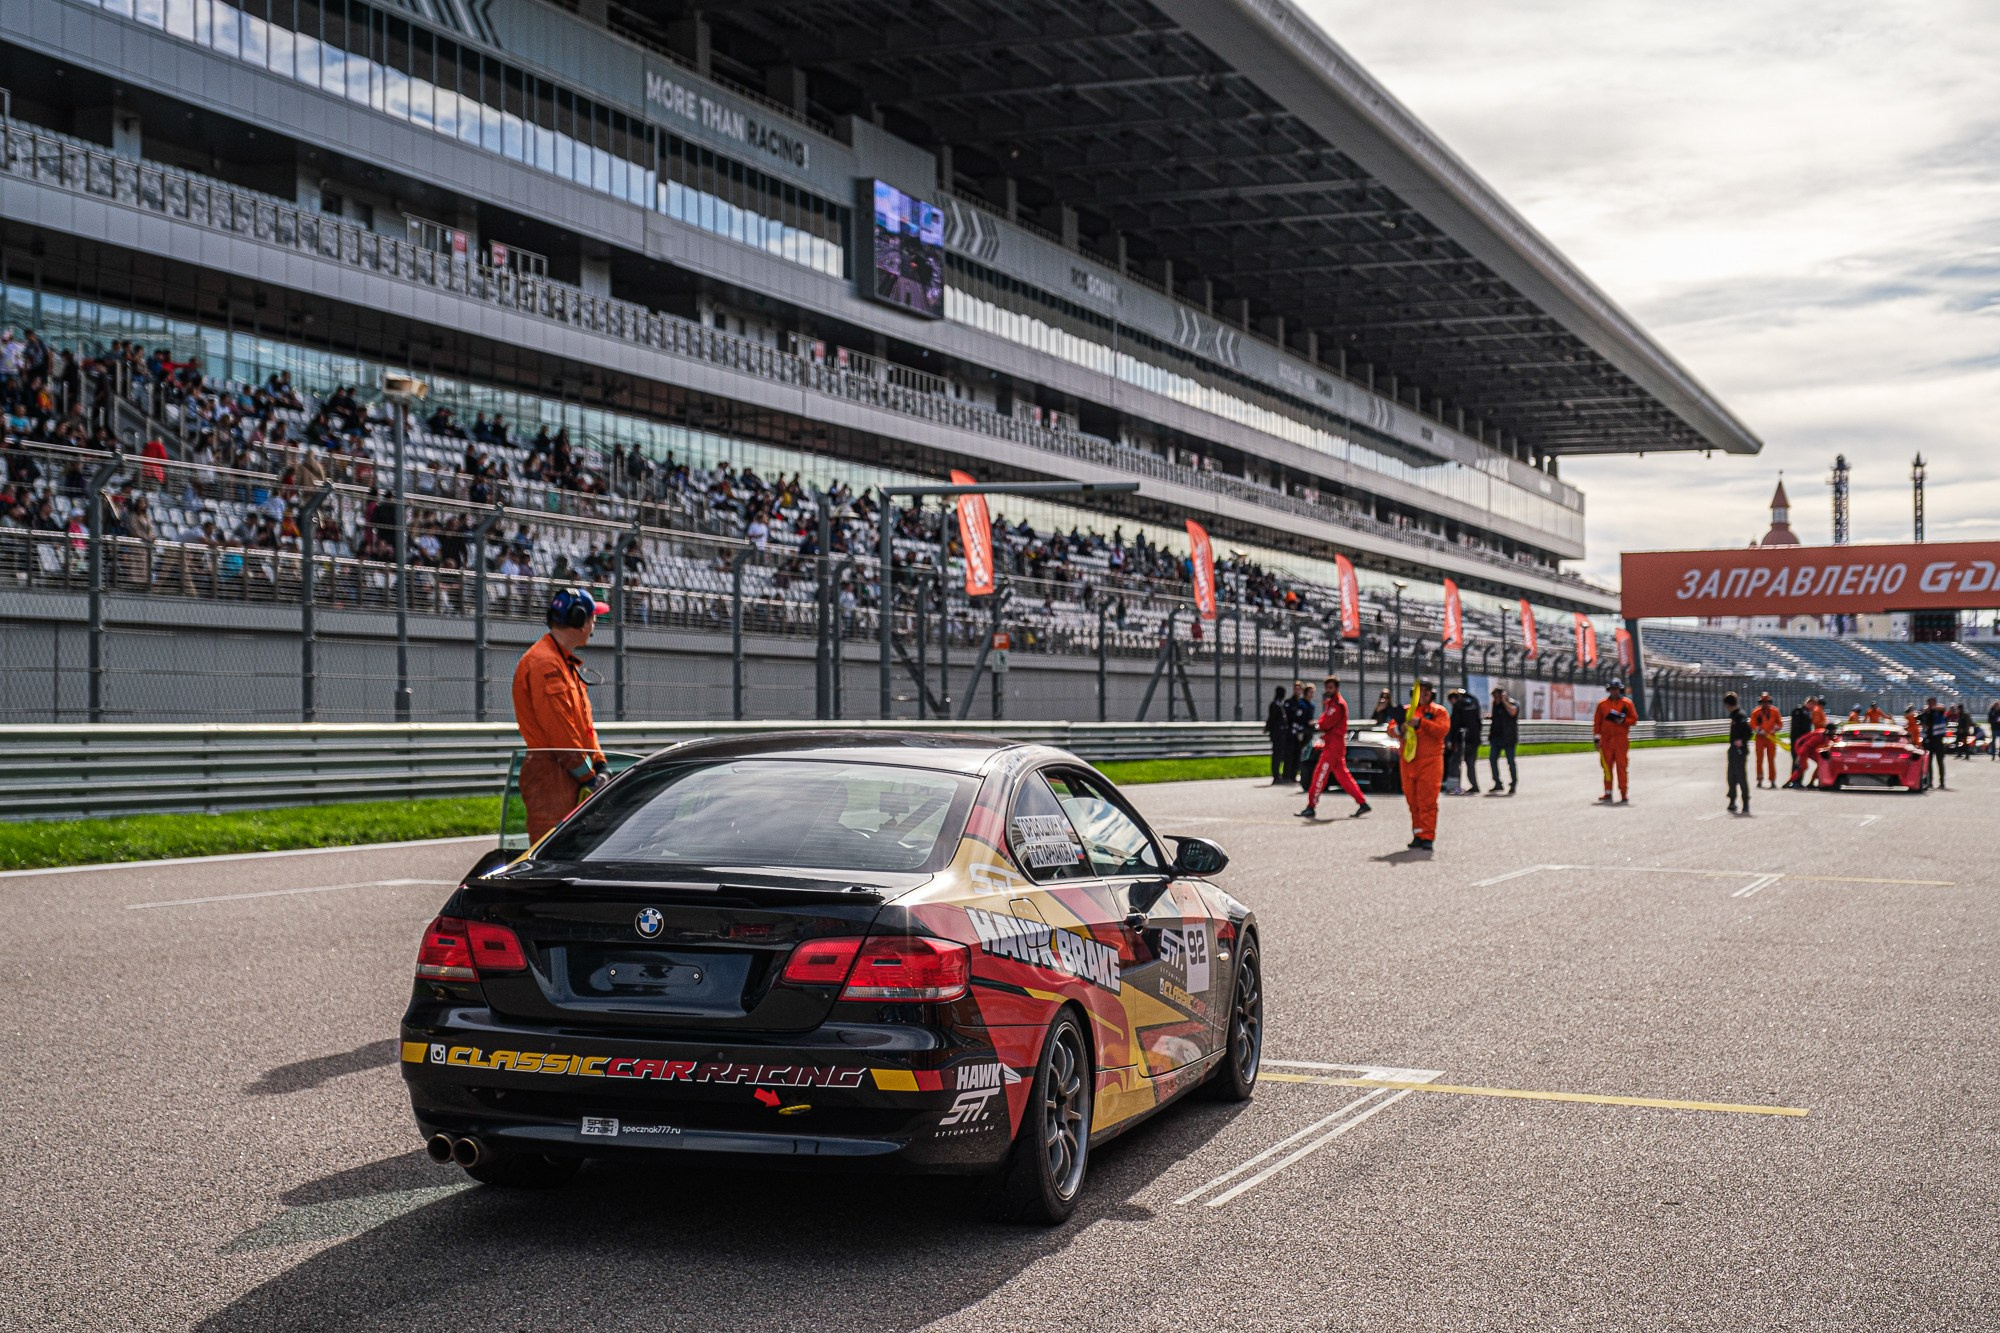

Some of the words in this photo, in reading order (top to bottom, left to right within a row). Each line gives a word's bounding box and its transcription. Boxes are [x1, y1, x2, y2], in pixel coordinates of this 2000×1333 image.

[646, 71, 697, 121] MORE
[699, 96, 746, 143] THAN
[1675, 563, 1909, 600] ЗАПРАВЛЕНО
[638, 909, 662, 919] BMW
[964, 906, 1061, 969] HAWK
[1056, 926, 1121, 996] BRAKE
[1187, 929, 1206, 966] 92
[696, 1063, 867, 1088] RACING
[956, 1063, 1002, 1090] HAWK
[622, 1125, 681, 1134] specznak777.ru
[934, 1125, 995, 1138] STTUNING.RU
